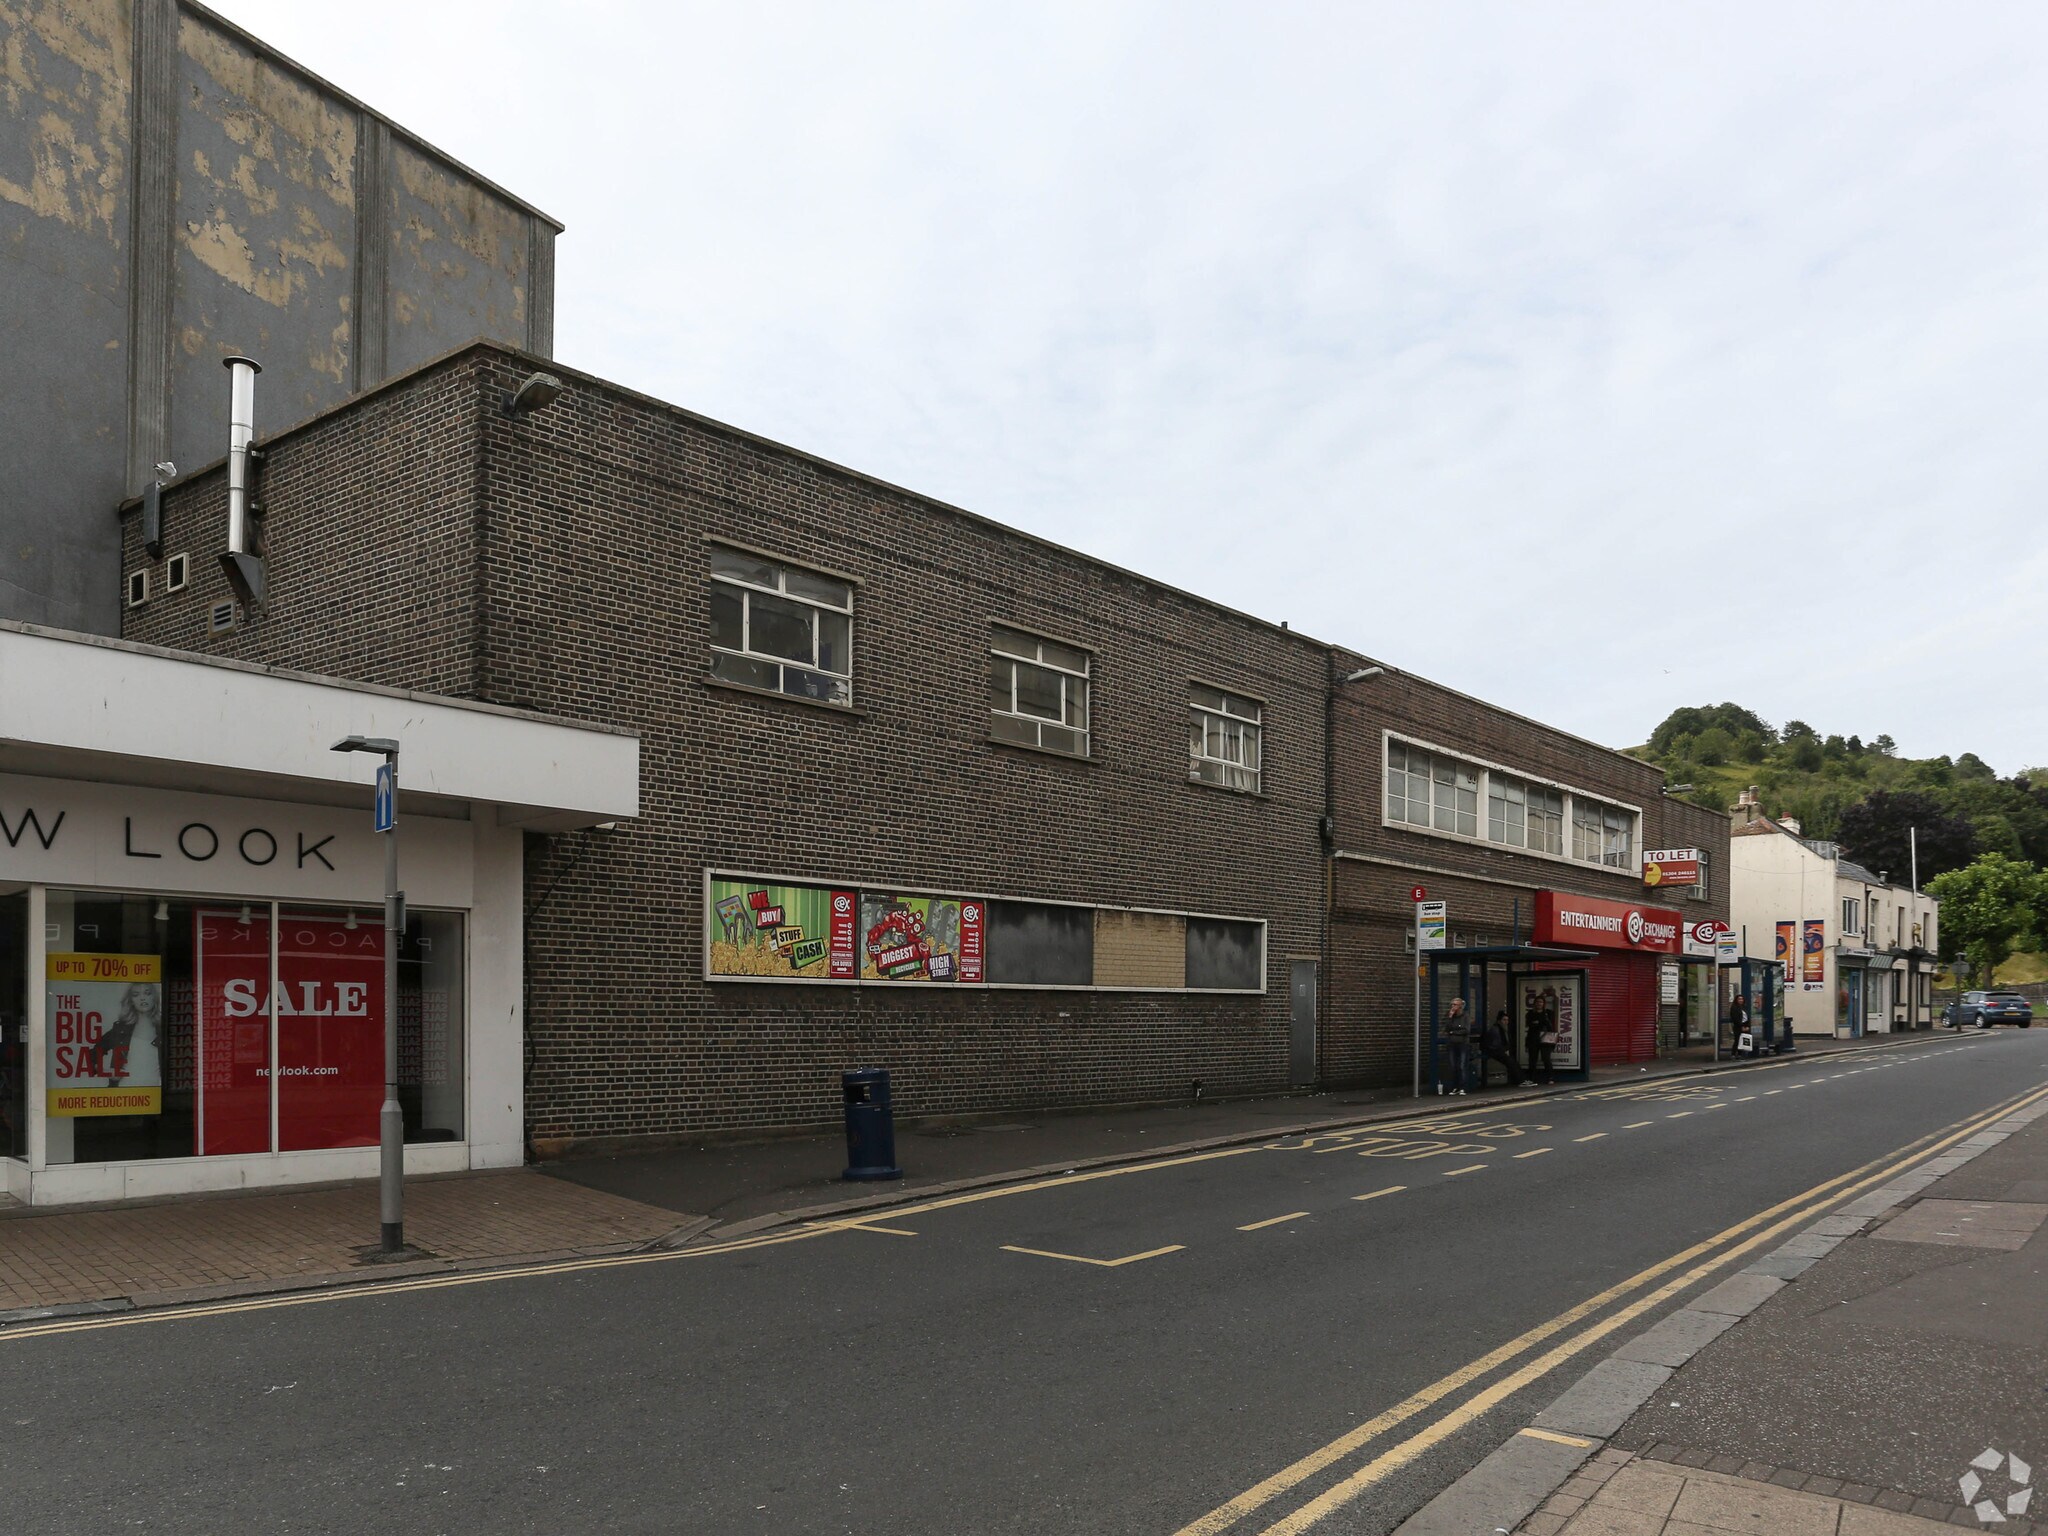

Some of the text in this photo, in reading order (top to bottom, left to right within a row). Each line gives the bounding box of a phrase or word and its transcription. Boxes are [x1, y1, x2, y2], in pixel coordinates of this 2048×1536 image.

[125, 816, 336, 872] LOOK
[1648, 850, 1692, 861] TO LET
[1415, 889, 1421, 898] E
[761, 911, 777, 923] BUY
[1560, 911, 1622, 932] ENTERTAINMENT
[1644, 922, 1676, 939] EXCHANGE
[779, 929, 801, 942] STUFF
[796, 941, 823, 961] CASH
[881, 946, 914, 965] BIGGEST
[56, 958, 152, 977] UP TO 70% OFF
[929, 955, 949, 970] HIGH
[932, 969, 949, 977] STREET
[56, 995, 80, 1009] THE
[223, 978, 368, 1018] SALE
[1560, 986, 1573, 1035] WATER?
[55, 1012, 103, 1044] BIG
[55, 1047, 130, 1078] SALE
[58, 1096, 151, 1109] MORE REDUCTIONS
[1377, 1121, 1553, 1138] BUS
[1262, 1136, 1498, 1160] STOP
